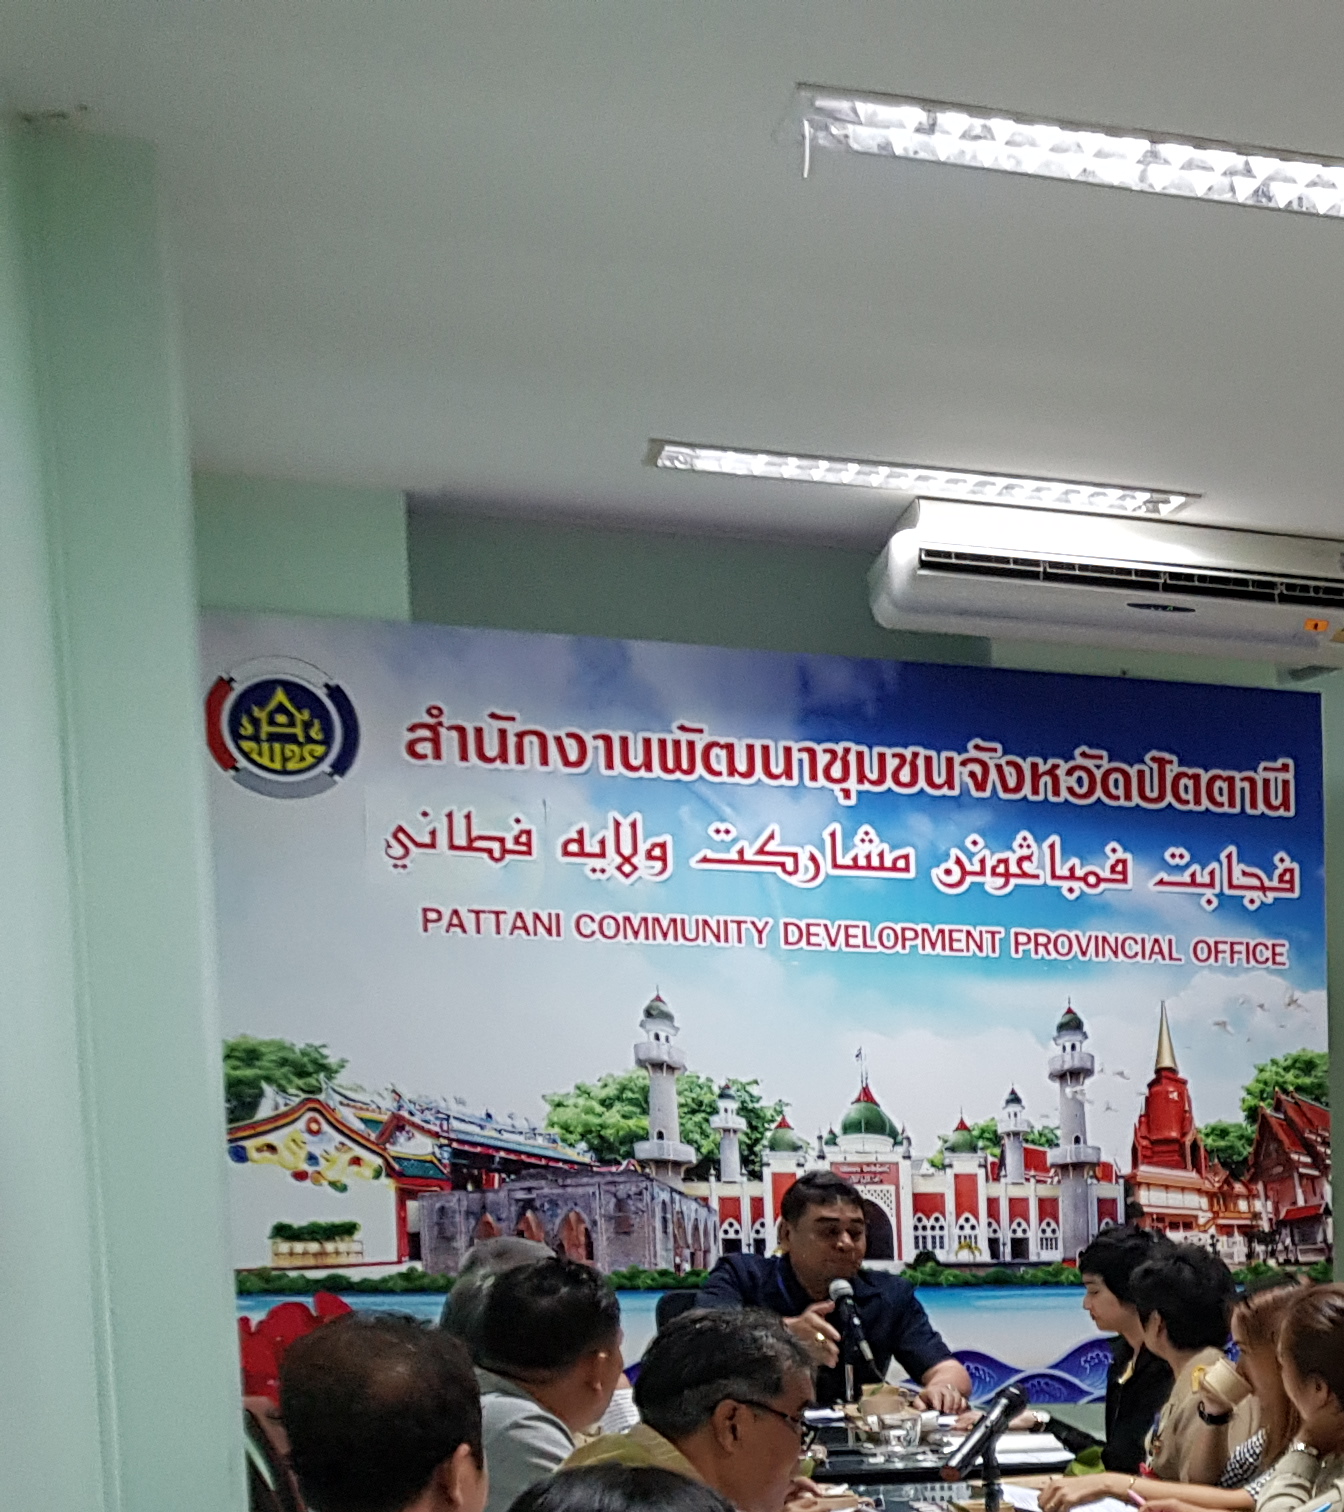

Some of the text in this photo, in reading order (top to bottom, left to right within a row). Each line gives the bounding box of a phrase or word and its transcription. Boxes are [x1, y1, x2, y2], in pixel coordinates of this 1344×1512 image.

[405, 704, 1295, 812] สำนักงานพัฒนาชุมชนจังหวัดปัตตานี
[421, 907, 1288, 967] PATTANI COMMUNITY DEVELOPMENT PROVINCIAL OFFICE
